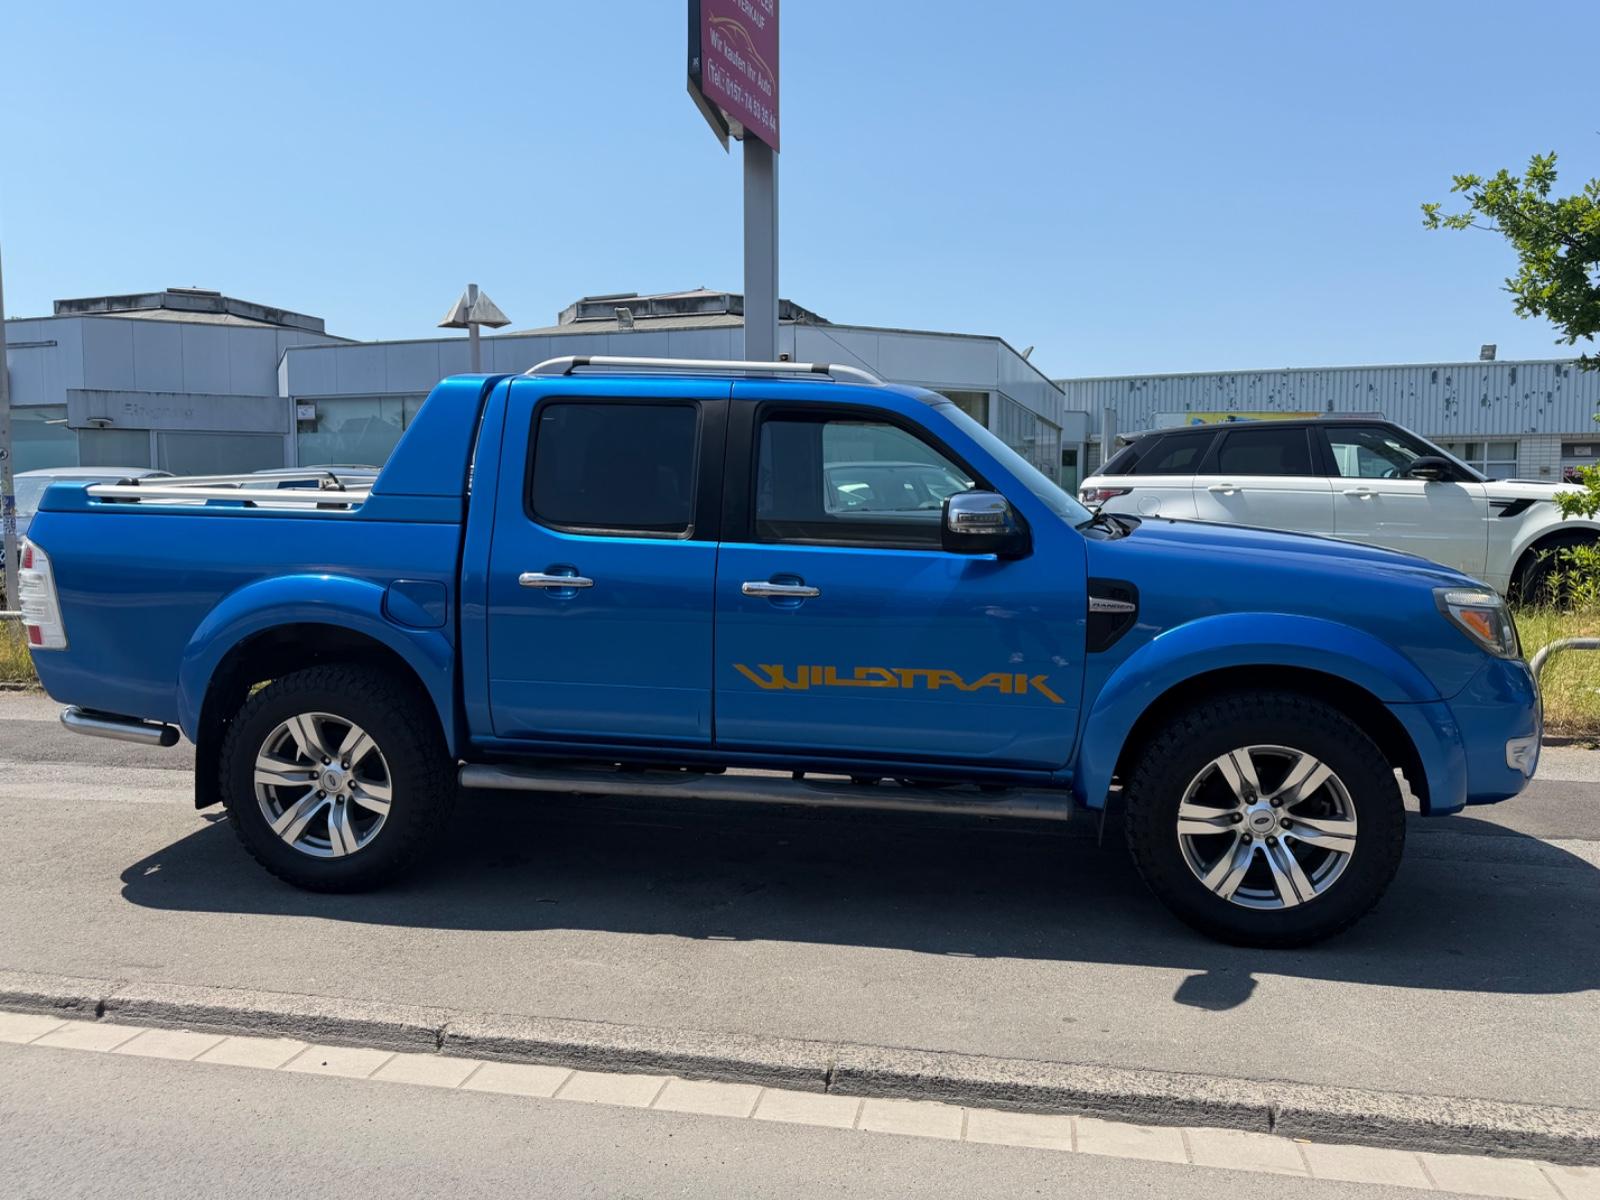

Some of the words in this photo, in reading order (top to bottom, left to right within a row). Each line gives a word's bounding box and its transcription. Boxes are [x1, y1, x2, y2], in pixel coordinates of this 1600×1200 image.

[710, 27, 721, 53] Wir
[723, 40, 746, 75] kaufen
[757, 71, 771, 97] Auto
